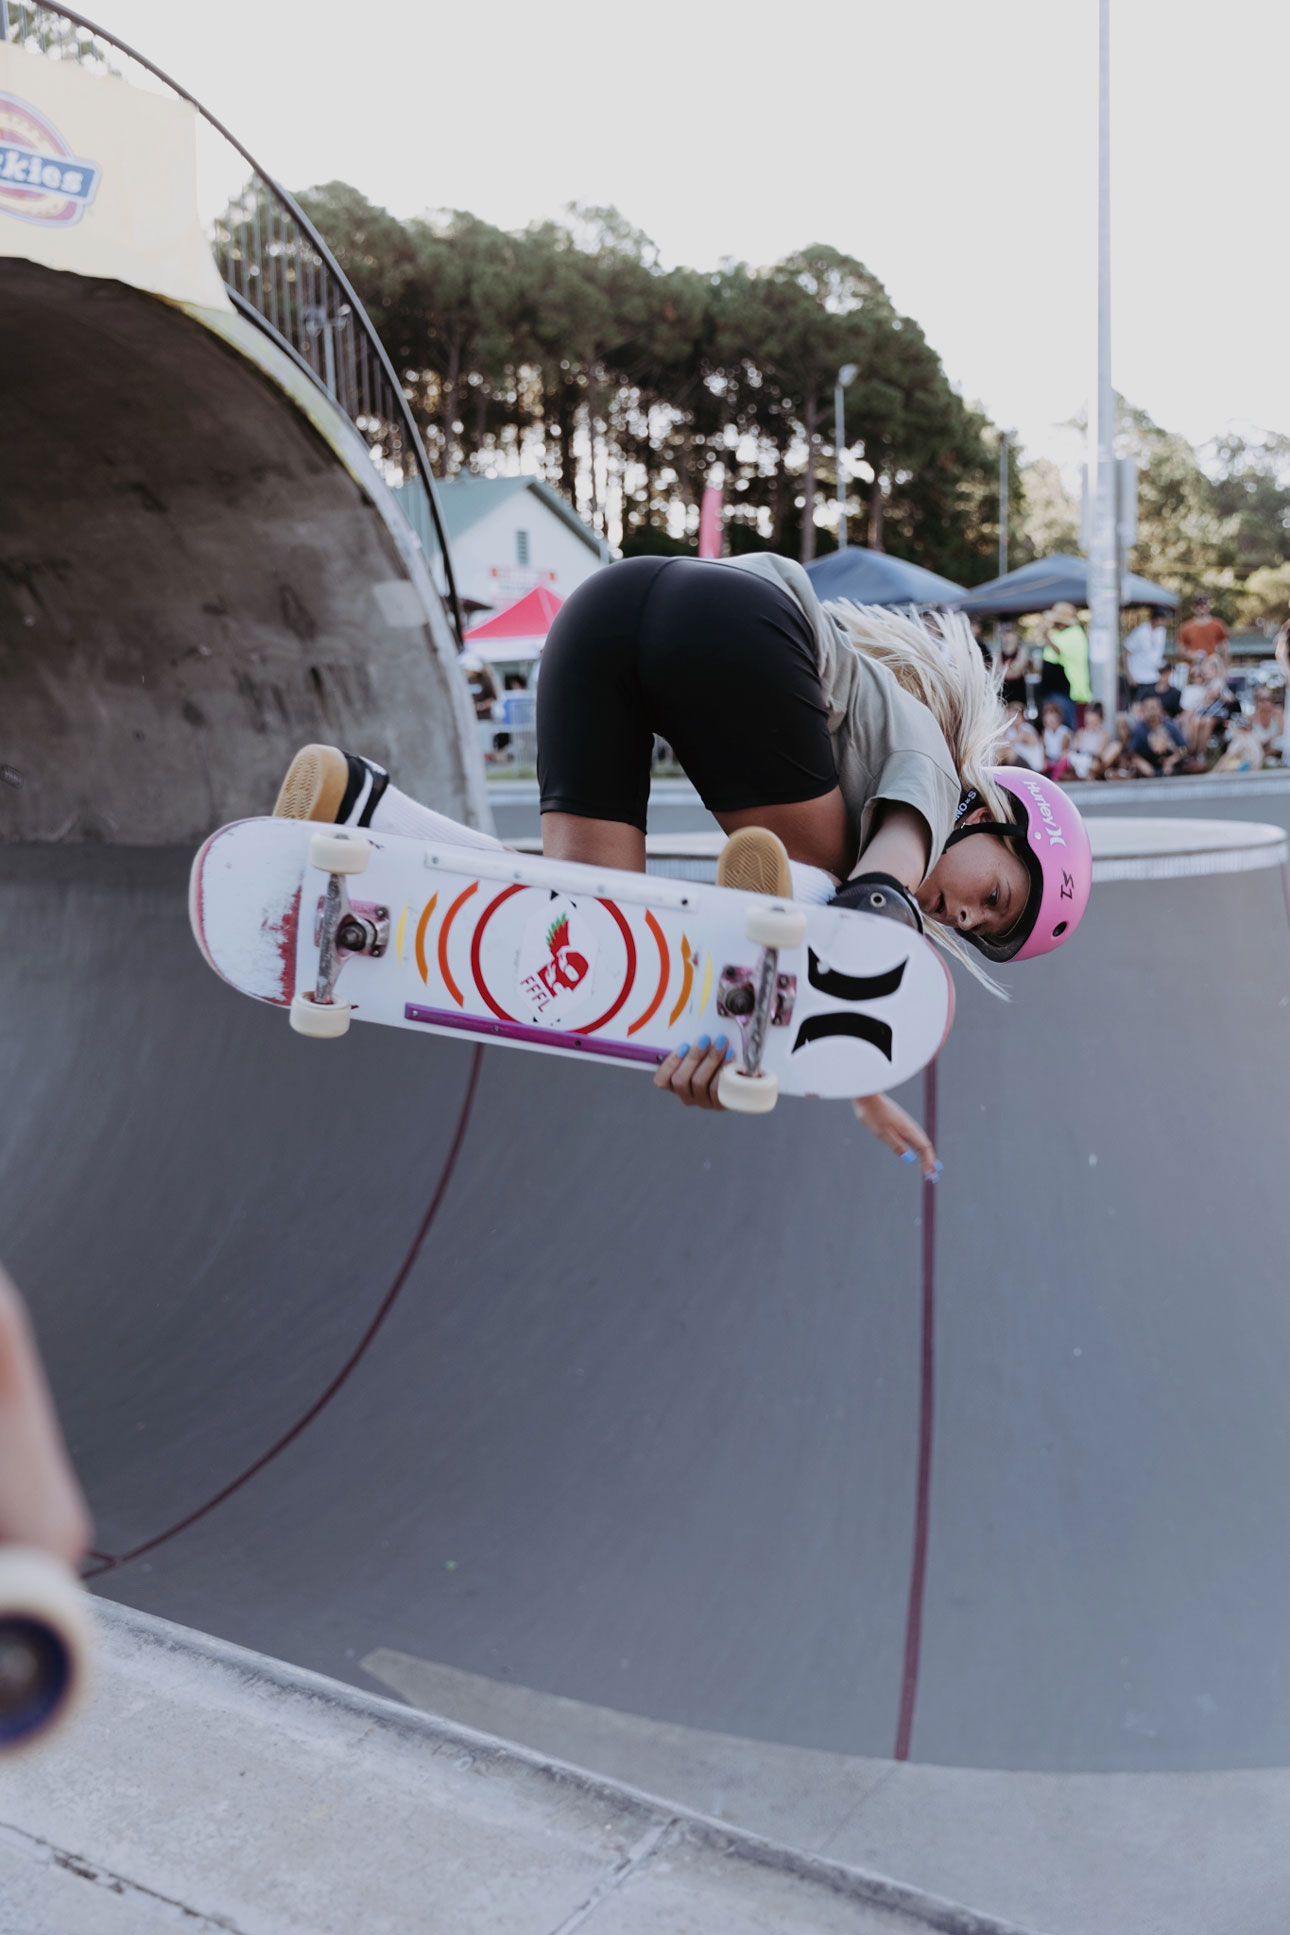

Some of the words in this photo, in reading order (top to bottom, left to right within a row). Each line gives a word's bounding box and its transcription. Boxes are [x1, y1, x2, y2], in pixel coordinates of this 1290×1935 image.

[0, 151, 84, 194] kies
[1023, 780, 1056, 827] Hurley
[520, 975, 550, 1013] FFFL
